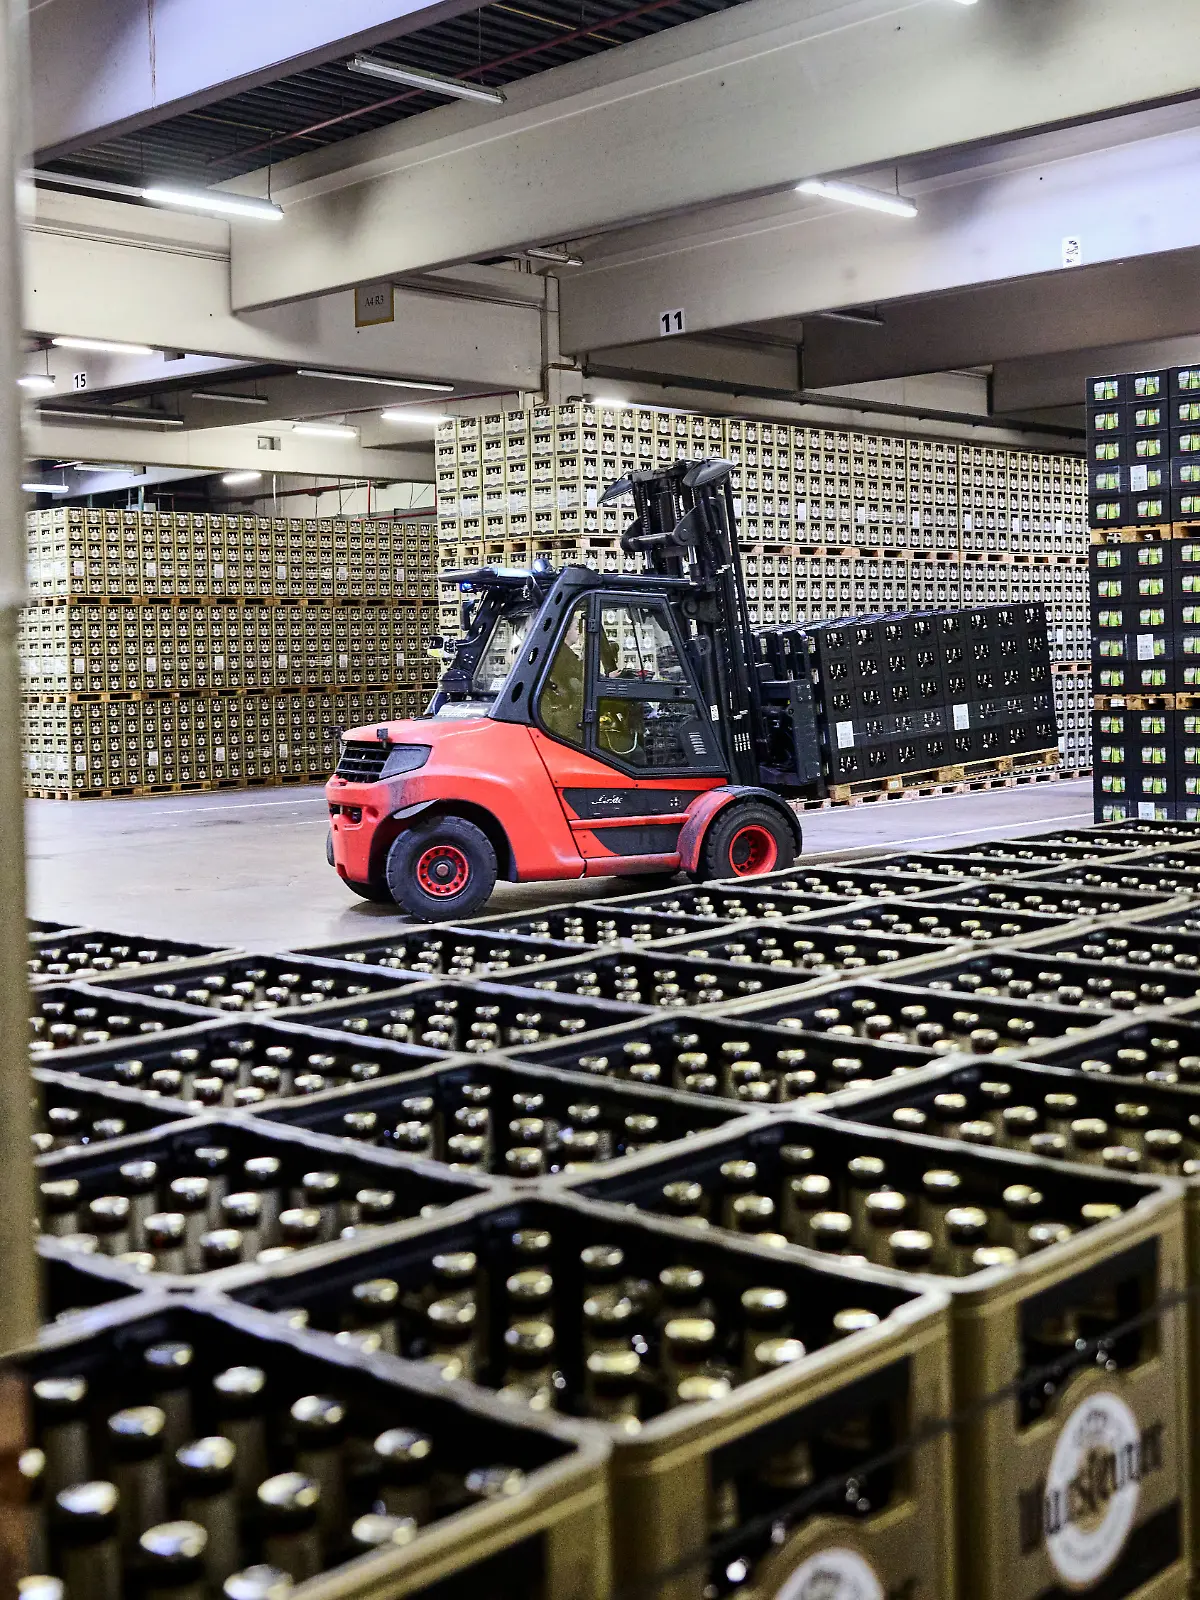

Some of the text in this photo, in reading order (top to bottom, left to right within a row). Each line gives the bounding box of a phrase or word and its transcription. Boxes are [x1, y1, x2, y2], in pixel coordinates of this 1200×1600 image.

[364, 297, 374, 307] A4
[661, 310, 683, 333] 11
[74, 373, 86, 389] 15
